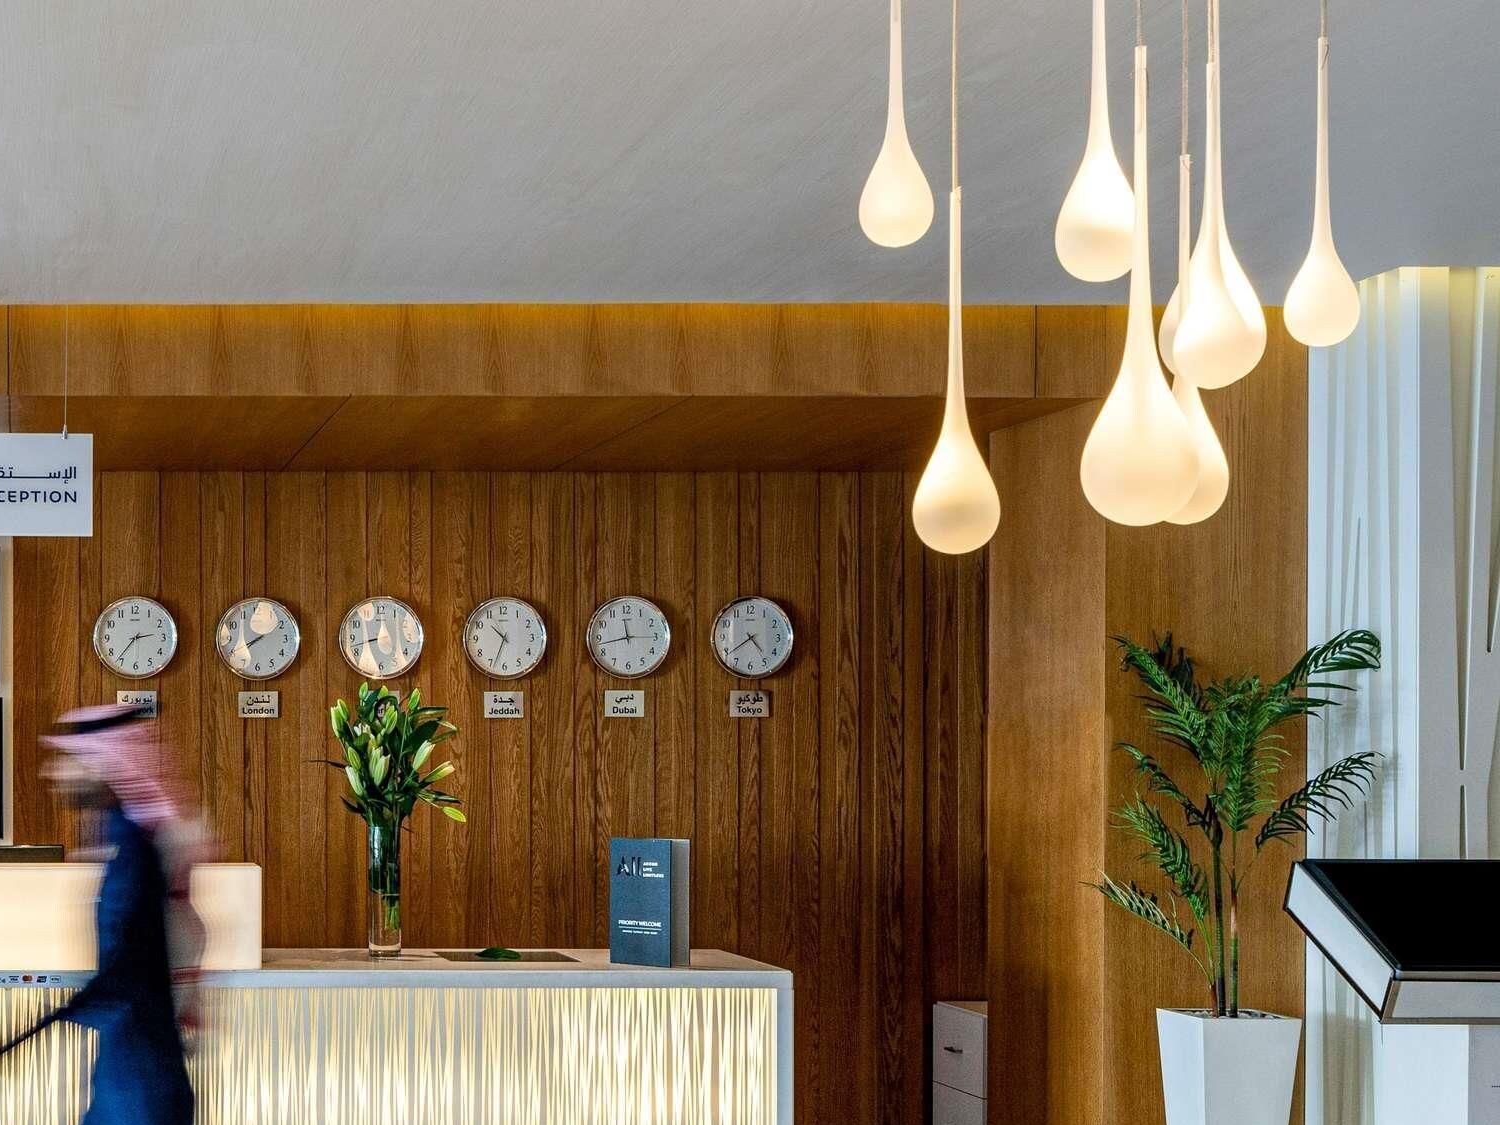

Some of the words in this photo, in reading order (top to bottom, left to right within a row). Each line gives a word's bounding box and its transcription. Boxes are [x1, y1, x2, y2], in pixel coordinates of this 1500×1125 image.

[118, 610, 124, 618] 11
[132, 606, 140, 614] 12
[148, 610, 150, 618] 1
[377, 606, 385, 614] 12
[394, 610, 396, 618] 1
[500, 606, 507, 615] 12
[516, 610, 519, 618] 1
[610, 610, 615, 618] 11
[623, 606, 631, 614] 12
[640, 609, 642, 617] 1
[734, 610, 739, 618] 11
[747, 606, 755, 614] 12
[763, 609, 765, 618] 1
[241, 611, 246, 619] 11
[487, 611, 492, 619] 11
[108, 621, 115, 629] 10
[157, 619, 162, 628] 2
[230, 621, 237, 630] 10
[280, 621, 284, 629] 2
[353, 620, 360, 629] 10
[476, 621, 483, 629] 10
[526, 620, 531, 628] 2
[599, 620, 606, 629] 10
[649, 618, 654, 627] 2
[723, 620, 730, 628] 10
[772, 620, 777, 628] 2
[105, 634, 110, 642] 9
[161, 634, 166, 642] 3
[284, 635, 288, 643] 3
[350, 634, 355, 642] 9
[473, 635, 478, 643] 9
[530, 634, 534, 642] 3
[597, 634, 602, 642] 9
[653, 633, 658, 641] 3
[775, 634, 780, 642] 3
[109, 648, 114, 656] 8
[157, 648, 162, 656] 4
[354, 648, 359, 656] 8
[403, 648, 408, 656] 4
[478, 649, 482, 657] 8
[526, 648, 531, 656] 4
[601, 648, 606, 656] 8
[649, 647, 654, 655] 4
[724, 648, 729, 656] 8
[772, 648, 777, 656] 4
[120, 658, 124, 666] 7
[133, 662, 138, 670] 6
[148, 658, 152, 666] 5
[270, 659, 274, 667] 5
[488, 659, 493, 667] 7
[516, 658, 521, 667] 5
[612, 658, 616, 666] 7
[626, 662, 631, 670] 6
[640, 658, 644, 666] 5
[734, 658, 739, 666] 7
[748, 662, 753, 670] 6
[762, 658, 767, 666] 5
[255, 663, 260, 671] 6
[502, 663, 507, 671] 6
[247, 695, 270, 706] لندن
[493, 695, 514, 705] جدة
[736, 693, 763, 704] طوكيو
[737, 706, 762, 715] Tokyo
